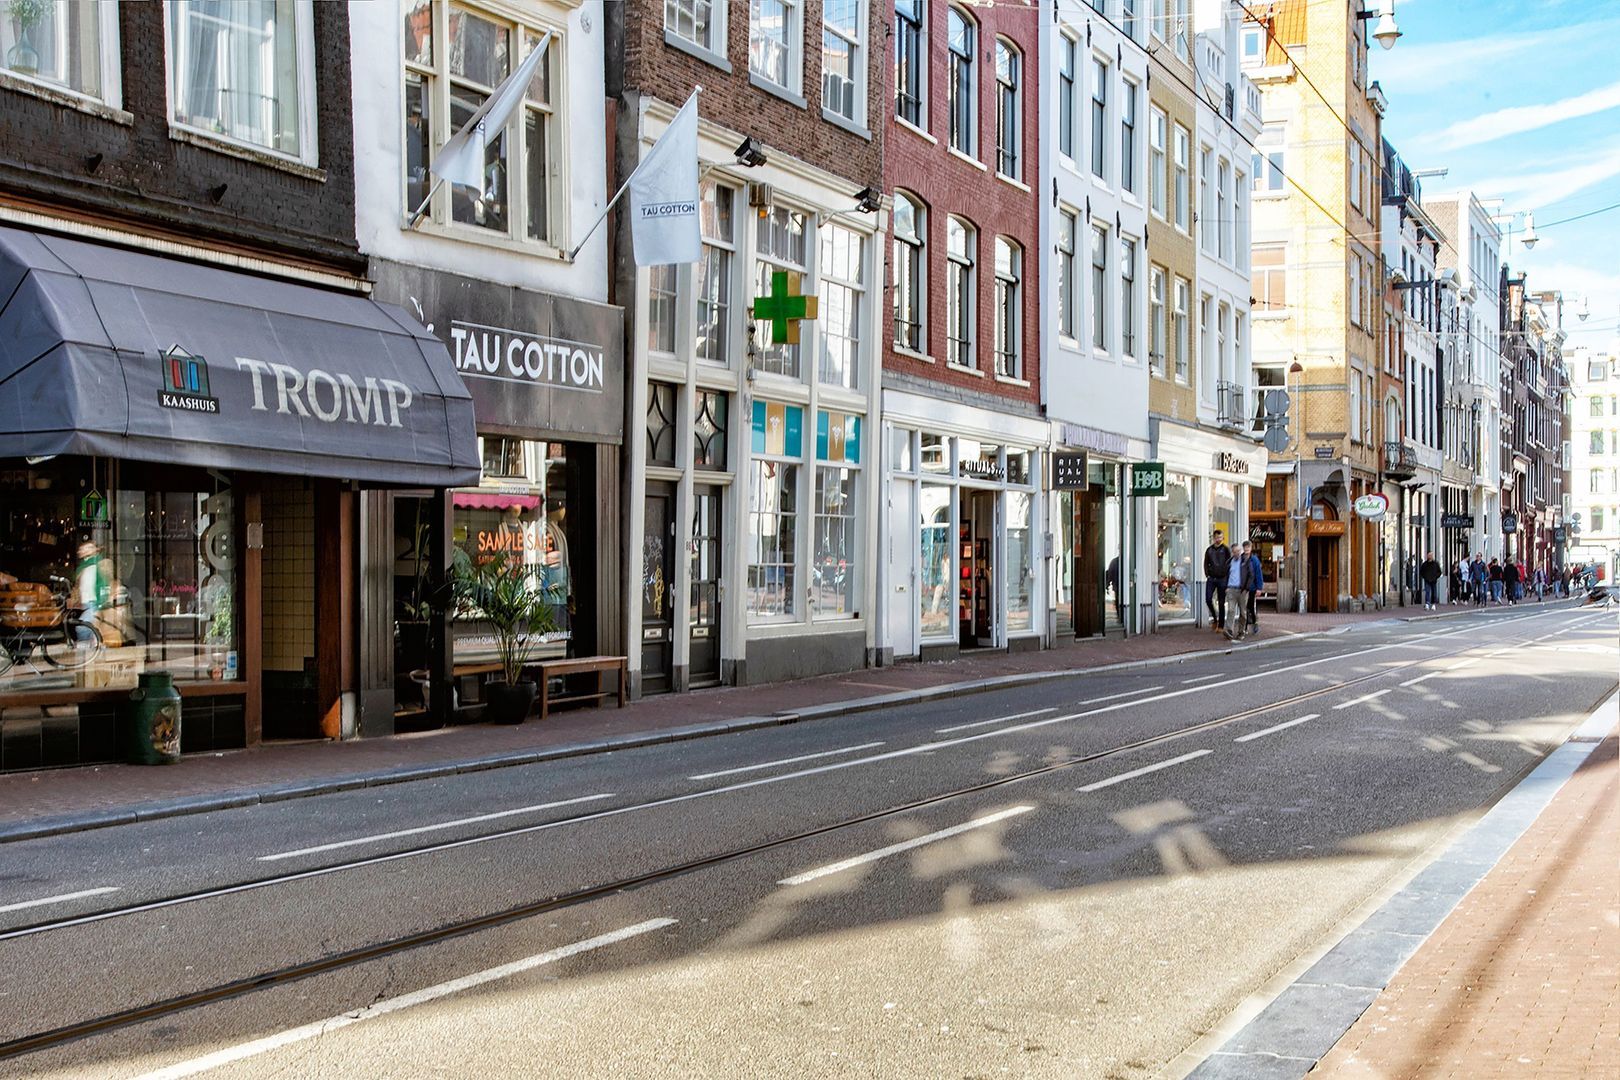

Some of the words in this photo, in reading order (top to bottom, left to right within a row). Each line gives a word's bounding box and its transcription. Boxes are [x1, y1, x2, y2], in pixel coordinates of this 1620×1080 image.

[641, 207, 658, 216] TAU
[659, 204, 695, 215] COTTON
[450, 327, 501, 374] TAU
[506, 337, 604, 388] COTTON
[235, 356, 413, 428] TROMP
[162, 394, 217, 413] KAASHUIS
[1134, 470, 1163, 489] H&B
[79, 521, 109, 529] KAASHUIS
[478, 530, 523, 552] SAMPLE
[527, 531, 553, 552] SALE
